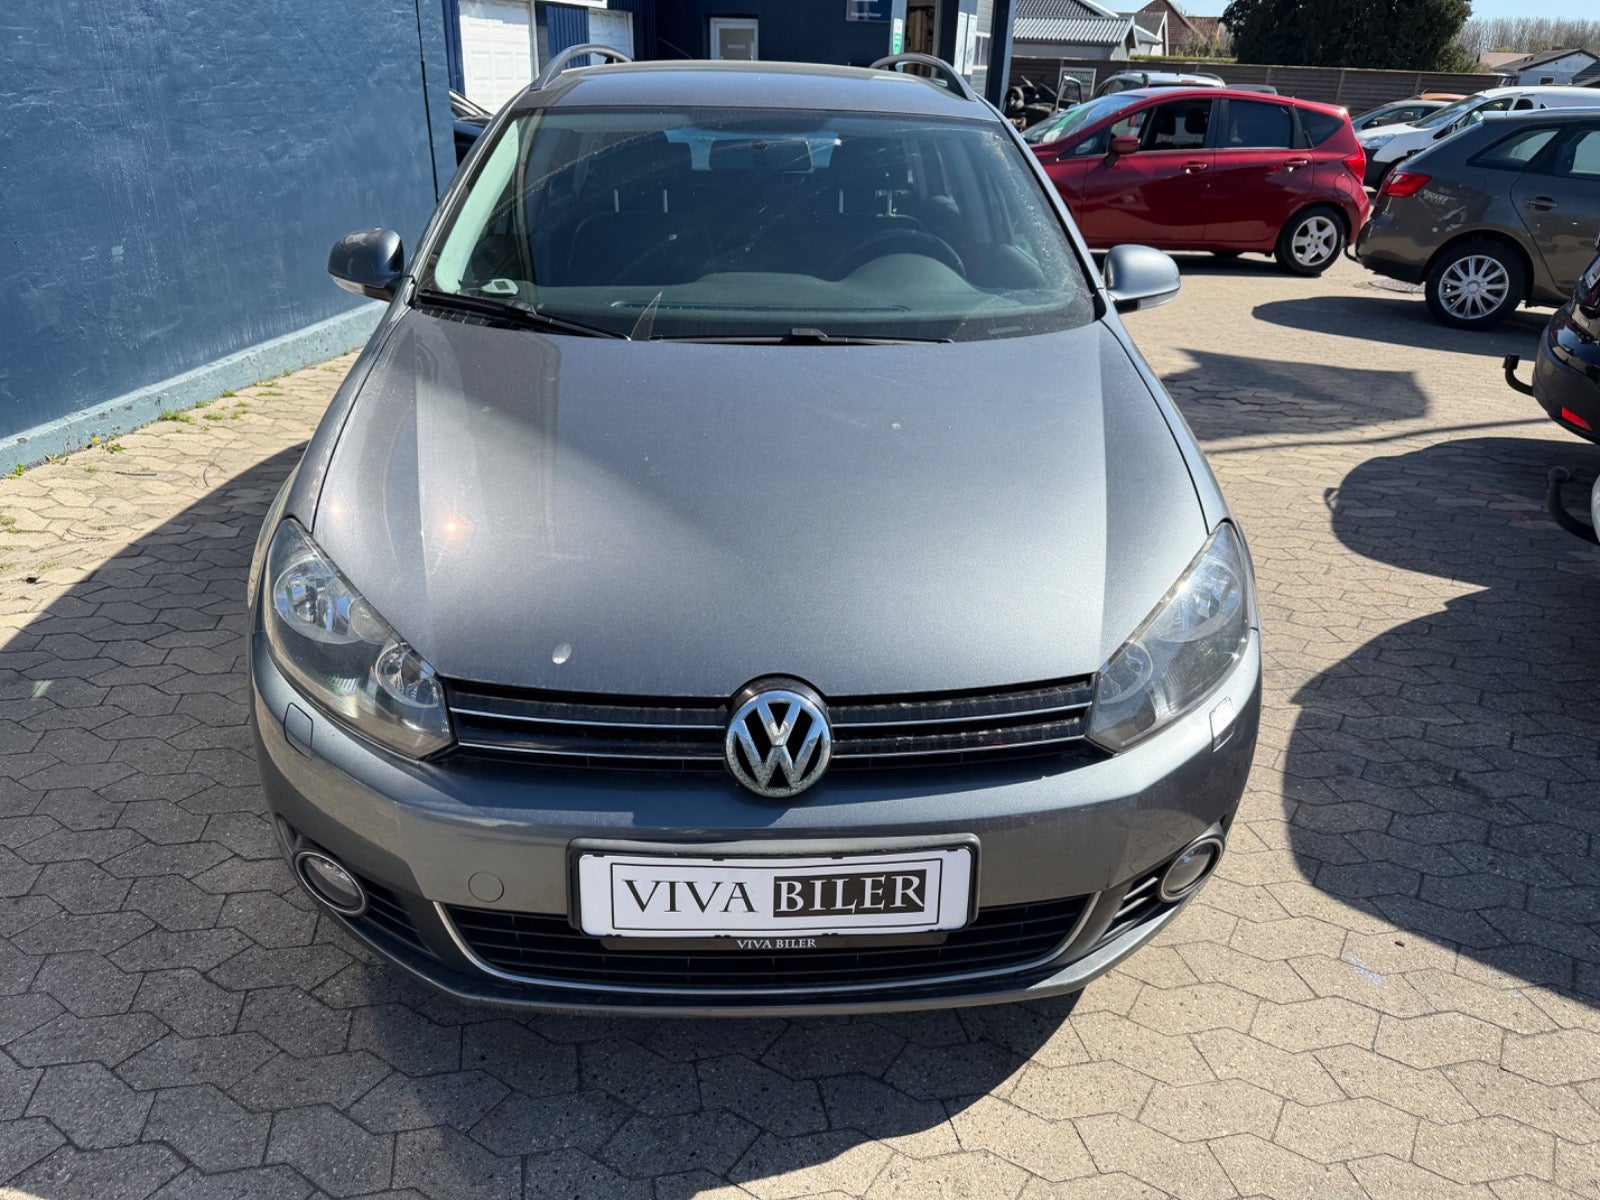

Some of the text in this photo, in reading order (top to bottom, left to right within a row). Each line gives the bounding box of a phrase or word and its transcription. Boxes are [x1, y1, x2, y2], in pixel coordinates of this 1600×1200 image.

[621, 873, 926, 915] VIVA BILER
[737, 938, 817, 950] VIVA BILER
